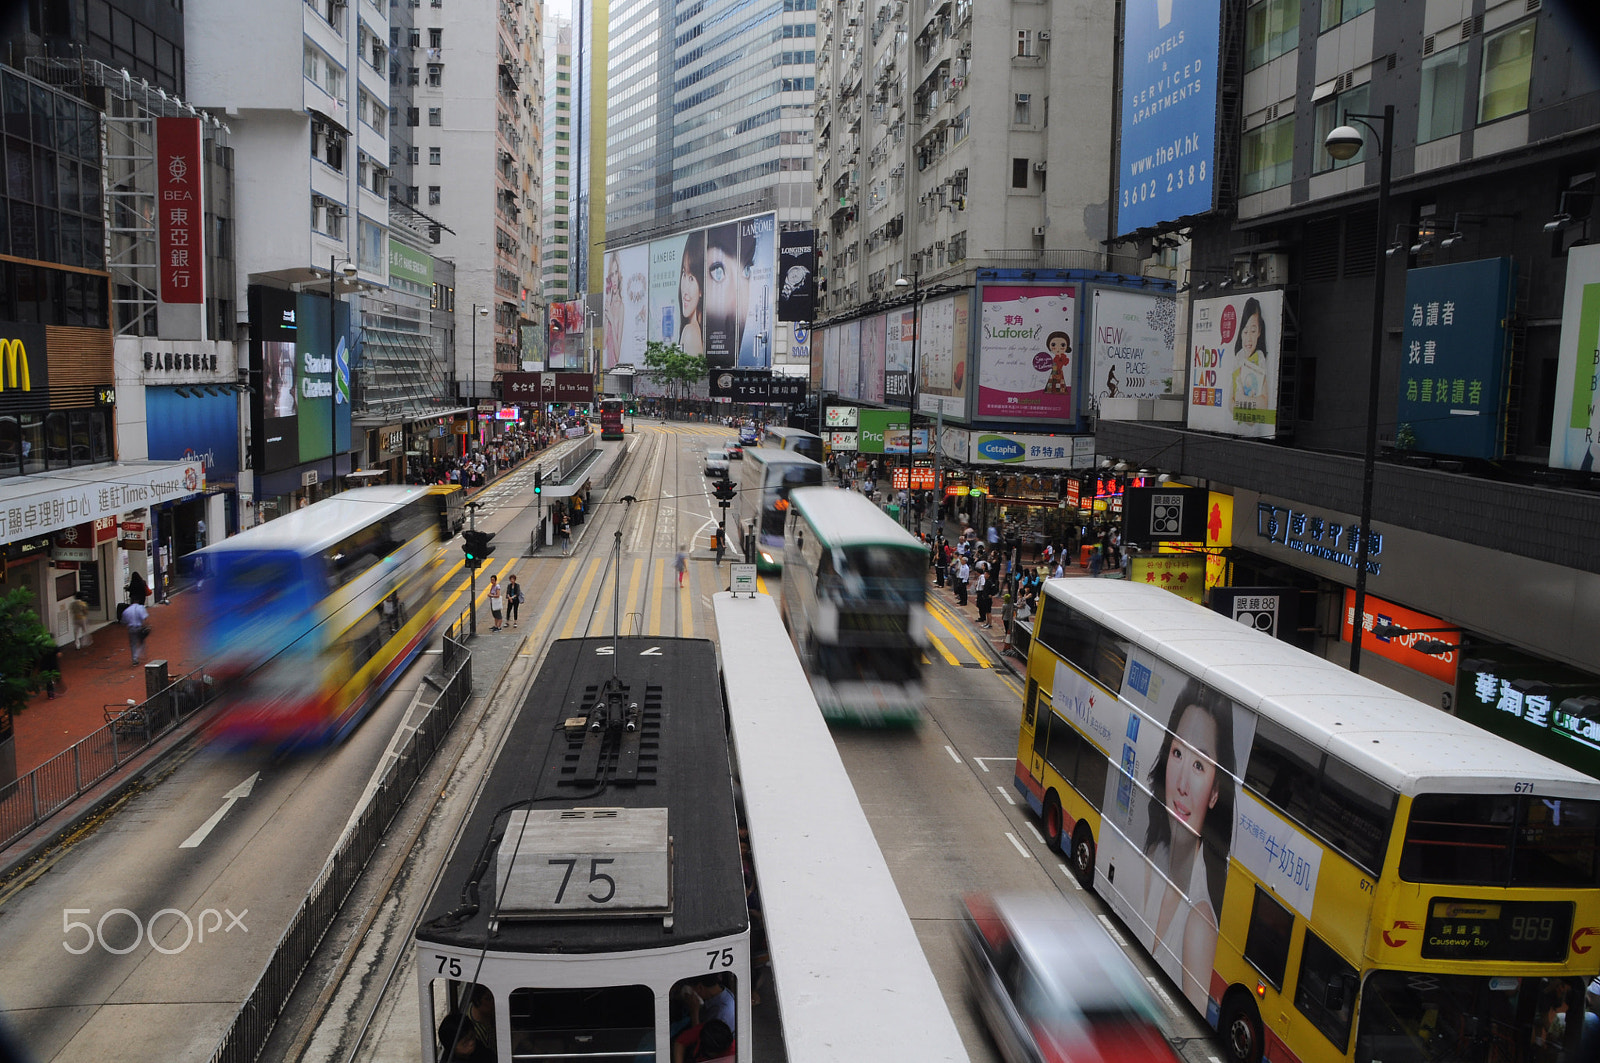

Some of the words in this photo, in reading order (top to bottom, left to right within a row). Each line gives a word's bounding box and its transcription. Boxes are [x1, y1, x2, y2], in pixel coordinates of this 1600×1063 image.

[1148, 30, 1184, 63] HOTELS
[1162, 62, 1168, 71] &
[1133, 59, 1202, 108] SERVICED
[1133, 79, 1201, 126] APARTMENTS
[1131, 132, 1199, 176] www.theV.hk
[1123, 179, 1156, 208] 3602
[1167, 160, 1206, 193] 2388
[164, 190, 193, 201] BEA
[169, 208, 191, 289] 東亞銀行
[653, 250, 676, 264] LANEIGE
[781, 246, 812, 254] LONGINES
[1004, 315, 1023, 326] 東角
[1411, 300, 1455, 328] 為讀者
[992, 327, 1033, 339] Laforet
[1098, 326, 1123, 345] NEW
[1107, 346, 1145, 361] CAUSEWAY
[1408, 340, 1437, 365] 找書
[1126, 362, 1146, 375] PLACE
[1193, 368, 1217, 387] LAND
[106, 390, 115, 402] 24
[511, 382, 536, 392] 余仁生
[739, 386, 766, 394] TSL
[1406, 377, 1482, 405] 為書找讀者
[985, 444, 1017, 456] Cetaphil
[1030, 445, 1065, 458] 舒特膚
[121, 484, 148, 503] Times
[150, 478, 180, 500] Square
[1236, 597, 1276, 610] 眼鏡88
[1474, 671, 1551, 728] 華潤堂
[1514, 782, 1535, 794] 671
[1264, 834, 1311, 892] 牛奶肌
[548, 858, 616, 905] 75
[1360, 878, 1374, 896] 671
[1510, 916, 1554, 941] 969
[1429, 937, 1471, 948] Causeway
[1474, 937, 1490, 948] Bay
[434, 954, 463, 978] 75
[706, 947, 735, 970] 75
